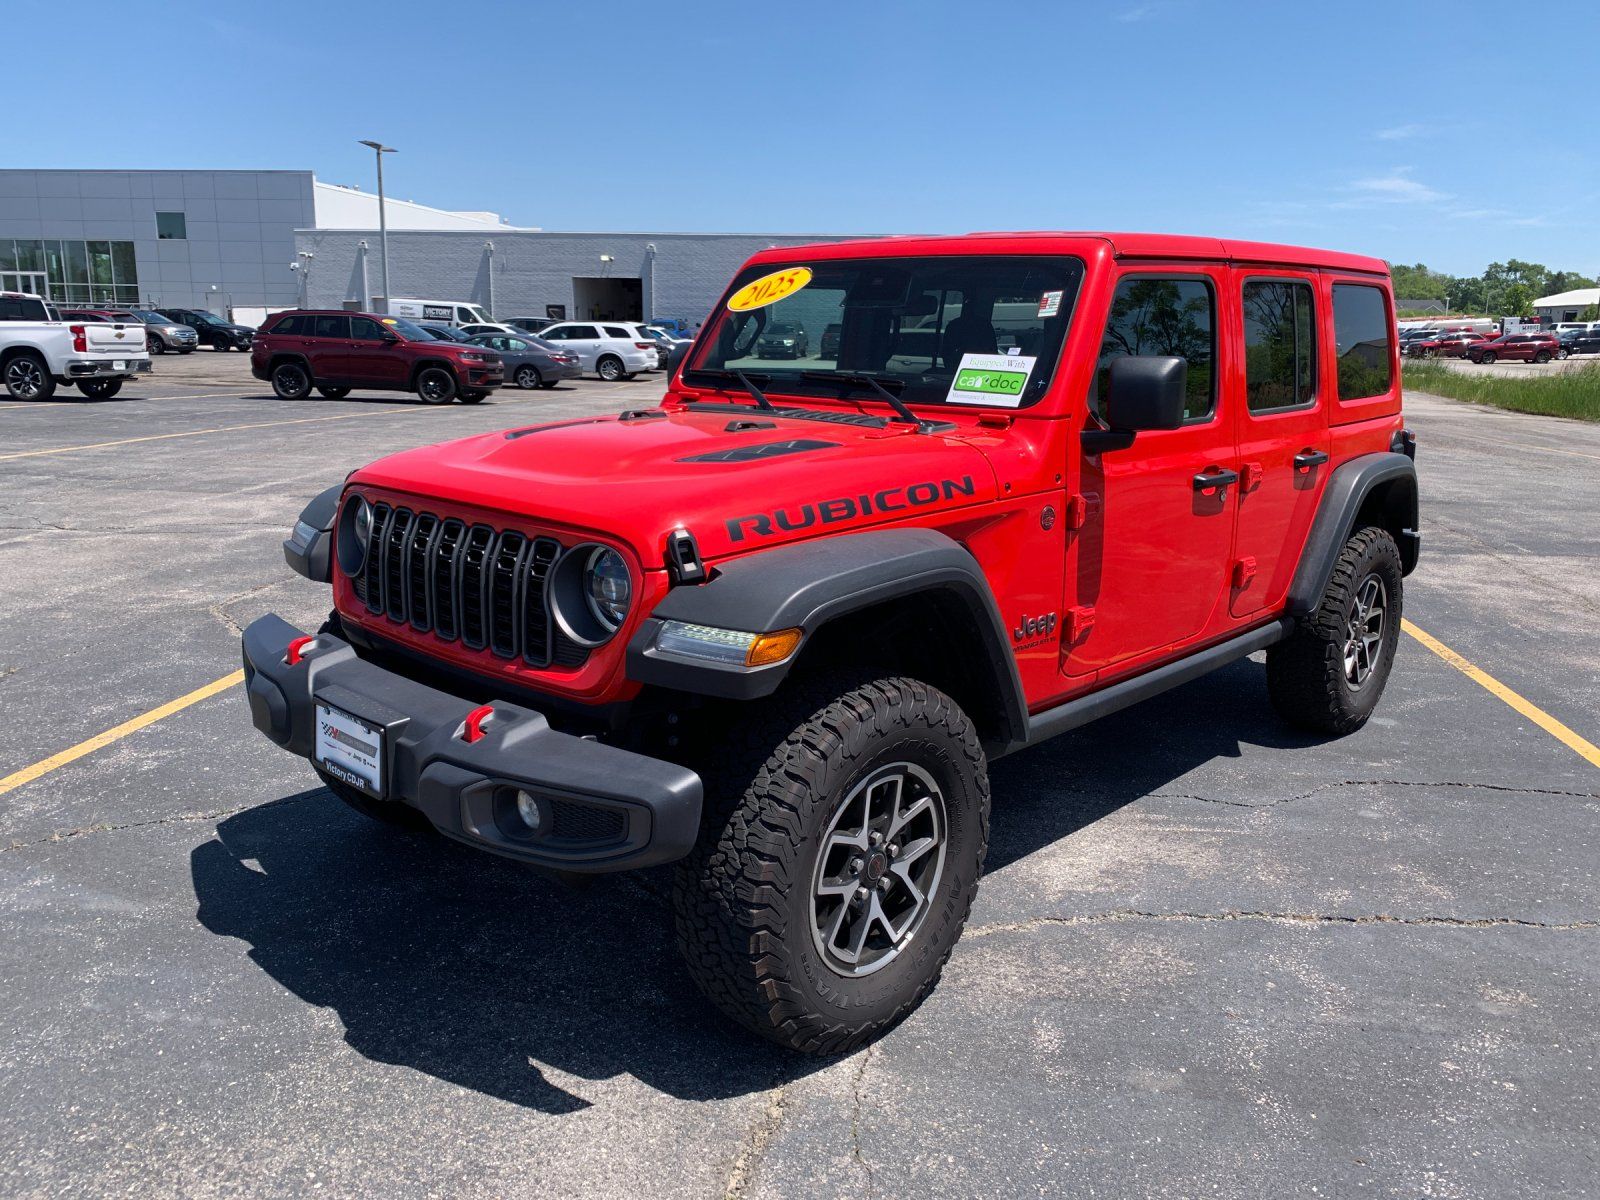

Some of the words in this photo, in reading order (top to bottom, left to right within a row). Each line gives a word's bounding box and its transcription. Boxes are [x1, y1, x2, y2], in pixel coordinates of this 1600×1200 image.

[740, 271, 801, 307] 2025
[425, 307, 451, 316] VICTORY
[1007, 359, 1026, 369] With
[725, 476, 975, 542] RUBICON
[1014, 612, 1057, 640] Jeep
[326, 761, 346, 781] Victory
[347, 773, 365, 789] CDJR
